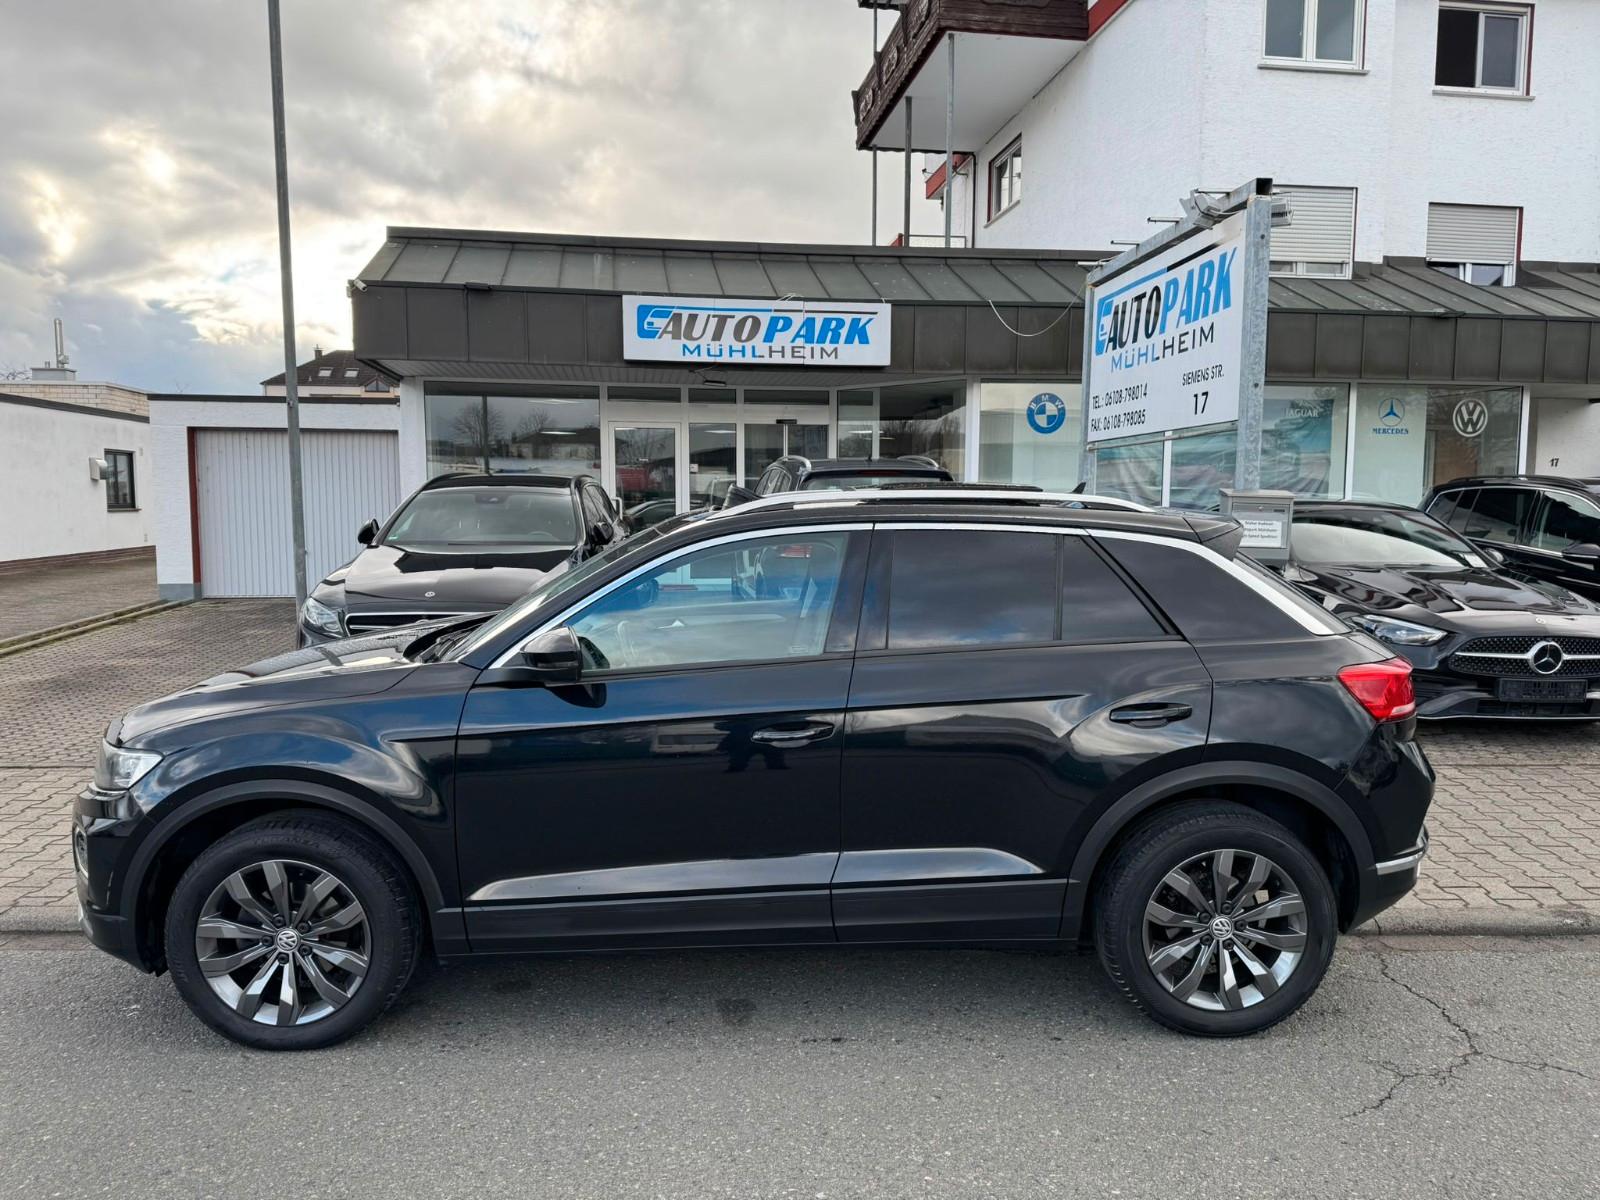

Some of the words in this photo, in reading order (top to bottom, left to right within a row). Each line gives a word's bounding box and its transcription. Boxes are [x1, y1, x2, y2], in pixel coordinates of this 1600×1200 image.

[682, 344, 839, 360] MÜHLHEIM
[1111, 321, 1215, 373] MÜHLHEIM
[1182, 368, 1209, 386] SIEMENS
[1211, 364, 1225, 380] STR.
[1105, 382, 1148, 407] 06108-798014
[1193, 391, 1209, 415] 17
[1550, 458, 1560, 468] 17
